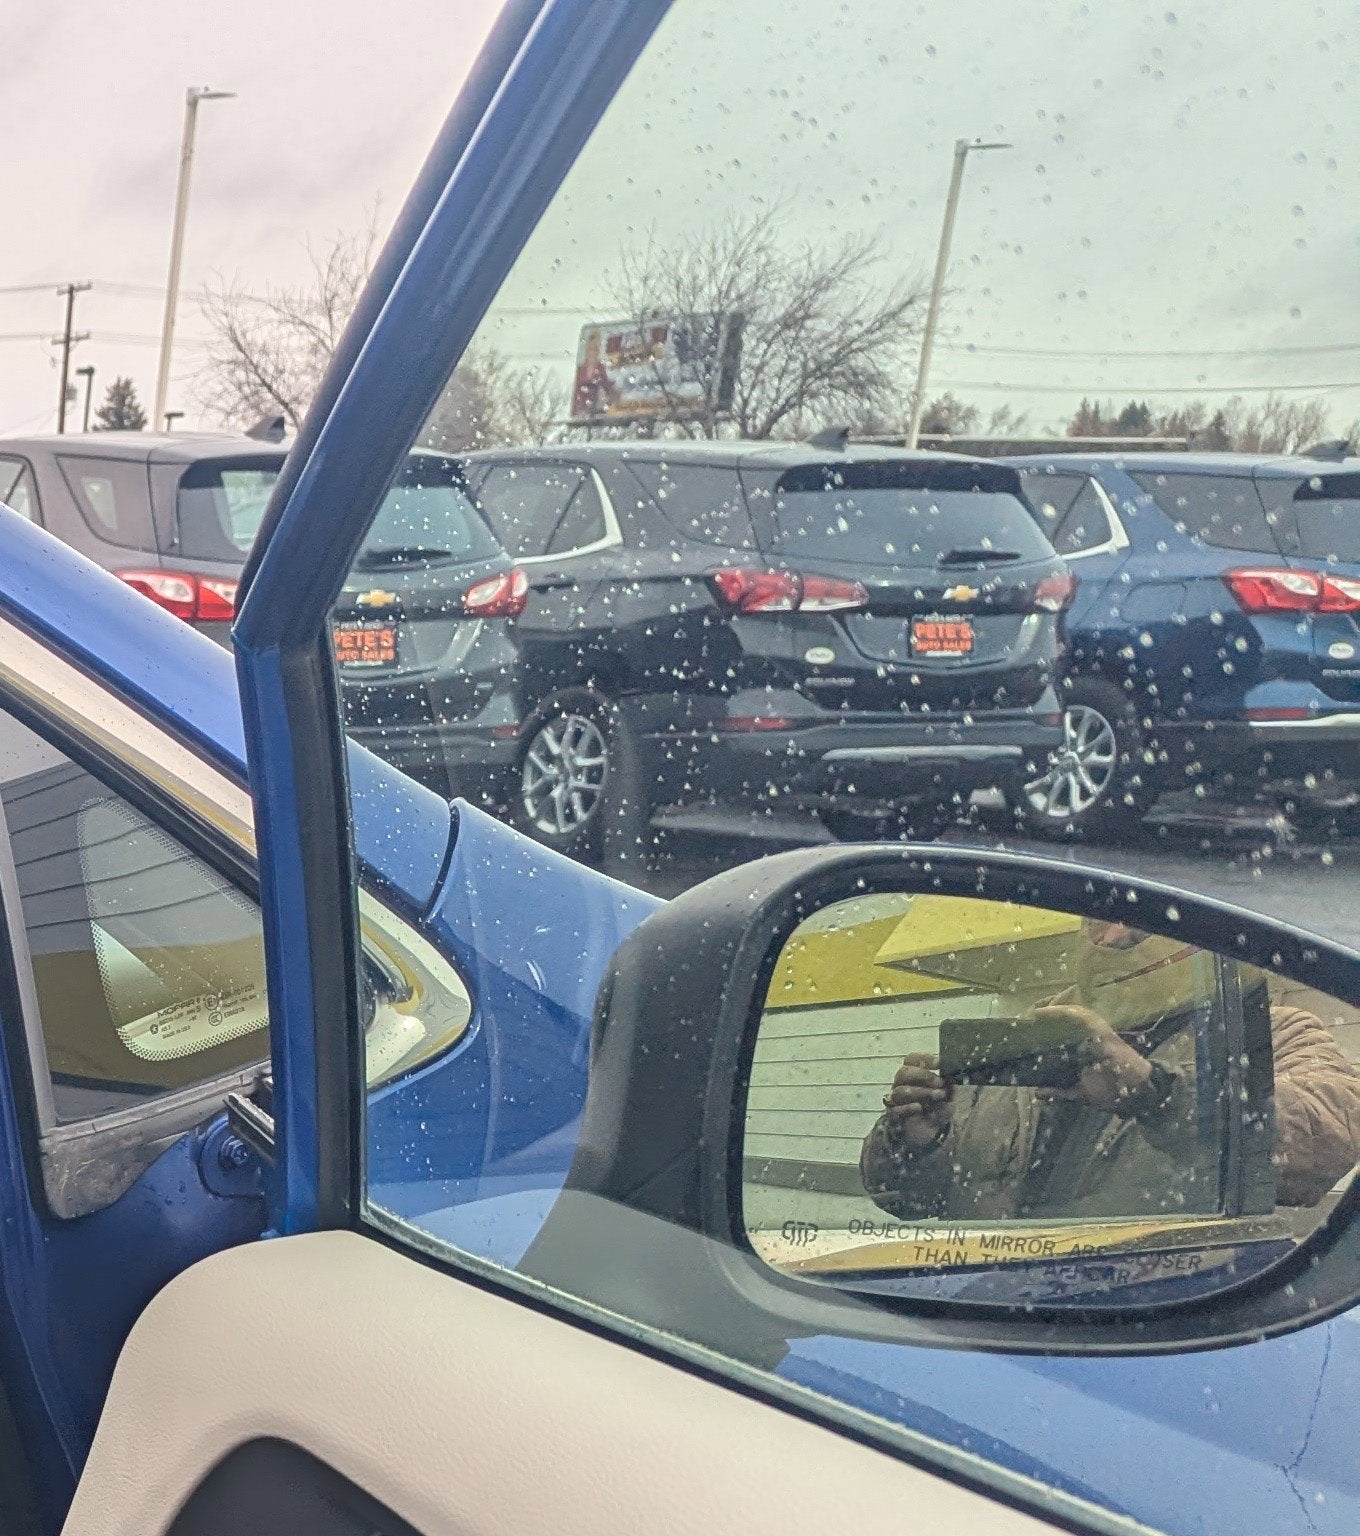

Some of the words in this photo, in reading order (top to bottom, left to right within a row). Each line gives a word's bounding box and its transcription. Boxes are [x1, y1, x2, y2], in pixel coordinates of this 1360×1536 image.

[848, 1218, 936, 1243] OBJECTS
[946, 1227, 967, 1246] IN
[979, 1233, 1056, 1257] MIRROR
[913, 1245, 968, 1266] THAN
